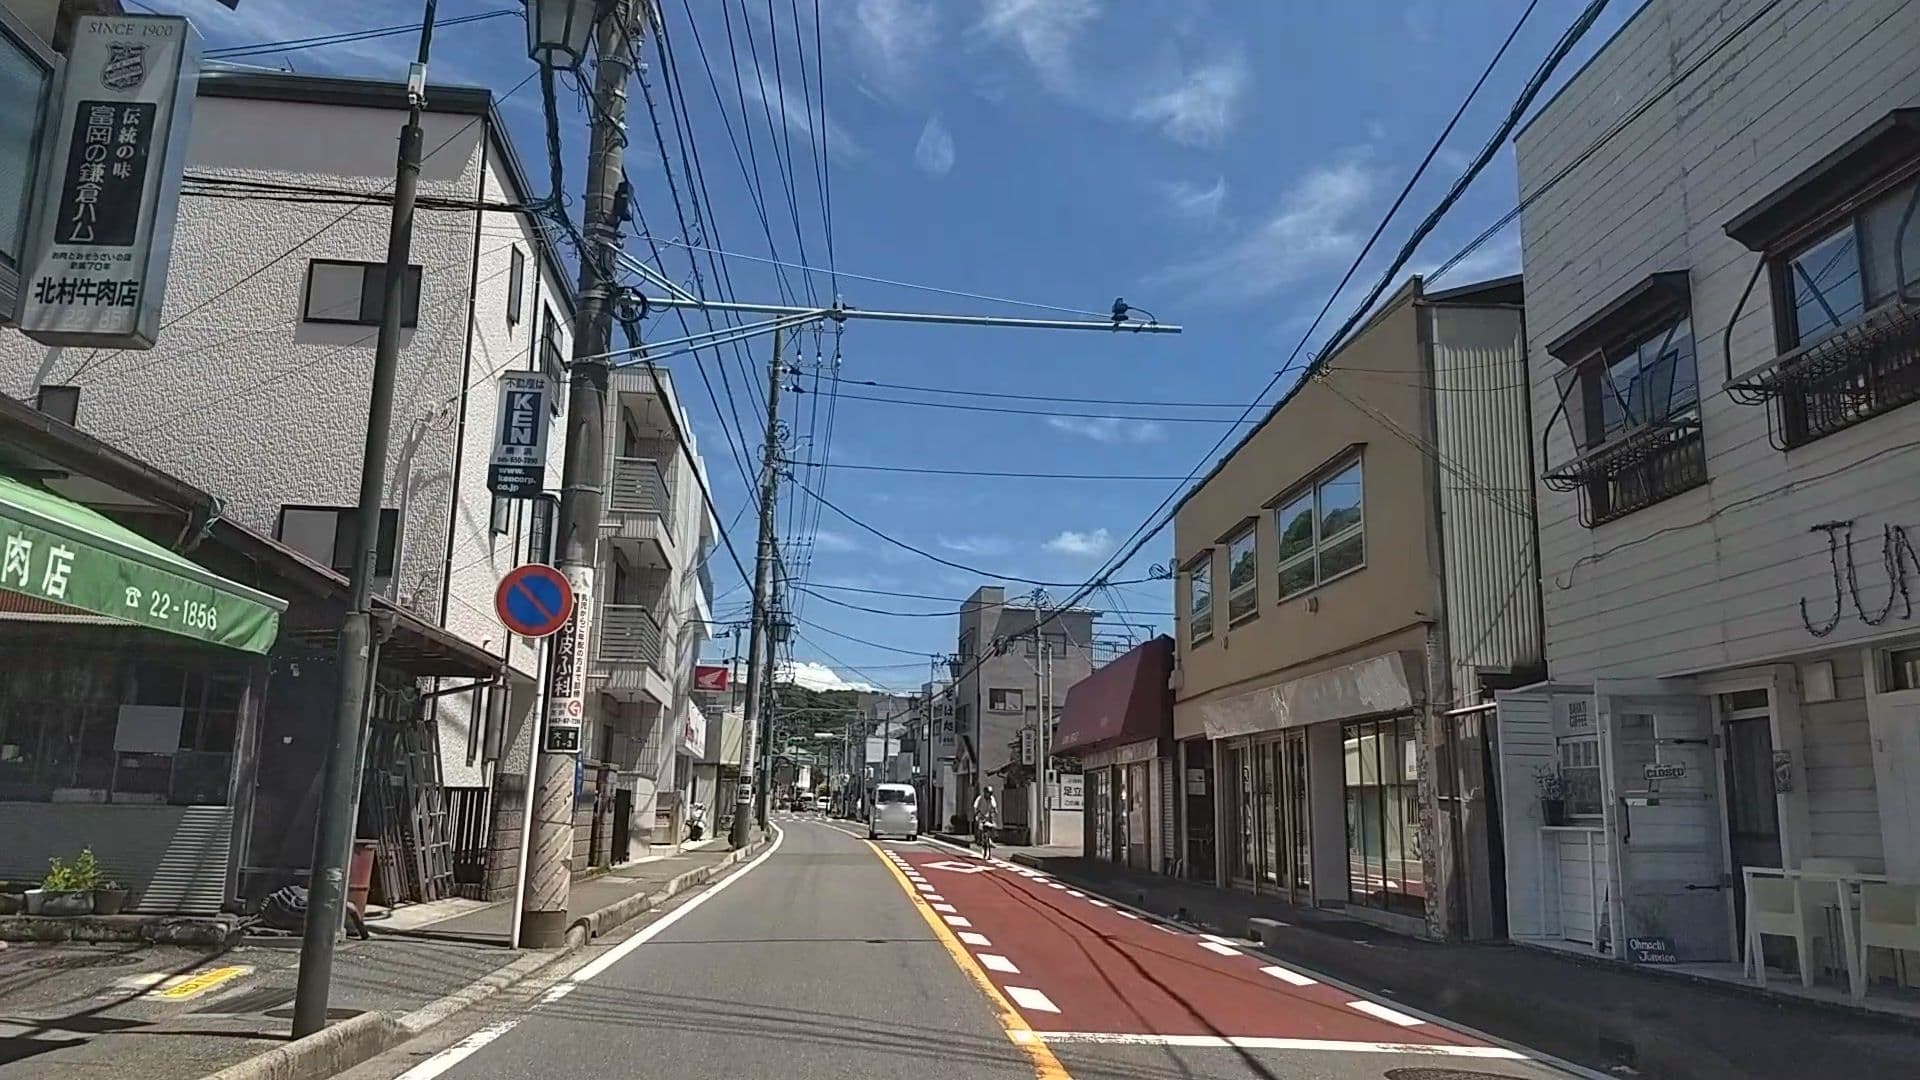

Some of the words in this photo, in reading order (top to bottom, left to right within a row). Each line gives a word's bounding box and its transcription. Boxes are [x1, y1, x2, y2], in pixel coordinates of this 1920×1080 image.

[88, 22, 135, 35] SINCE
[142, 25, 174, 37] 1900
[112, 108, 141, 180] 伝統の味
[69, 105, 116, 242] 富岡の鎌倉ハム
[34, 276, 139, 307] 北村牛肉店
[510, 393, 534, 444] KEN
[151, 590, 219, 632] 22-1856
